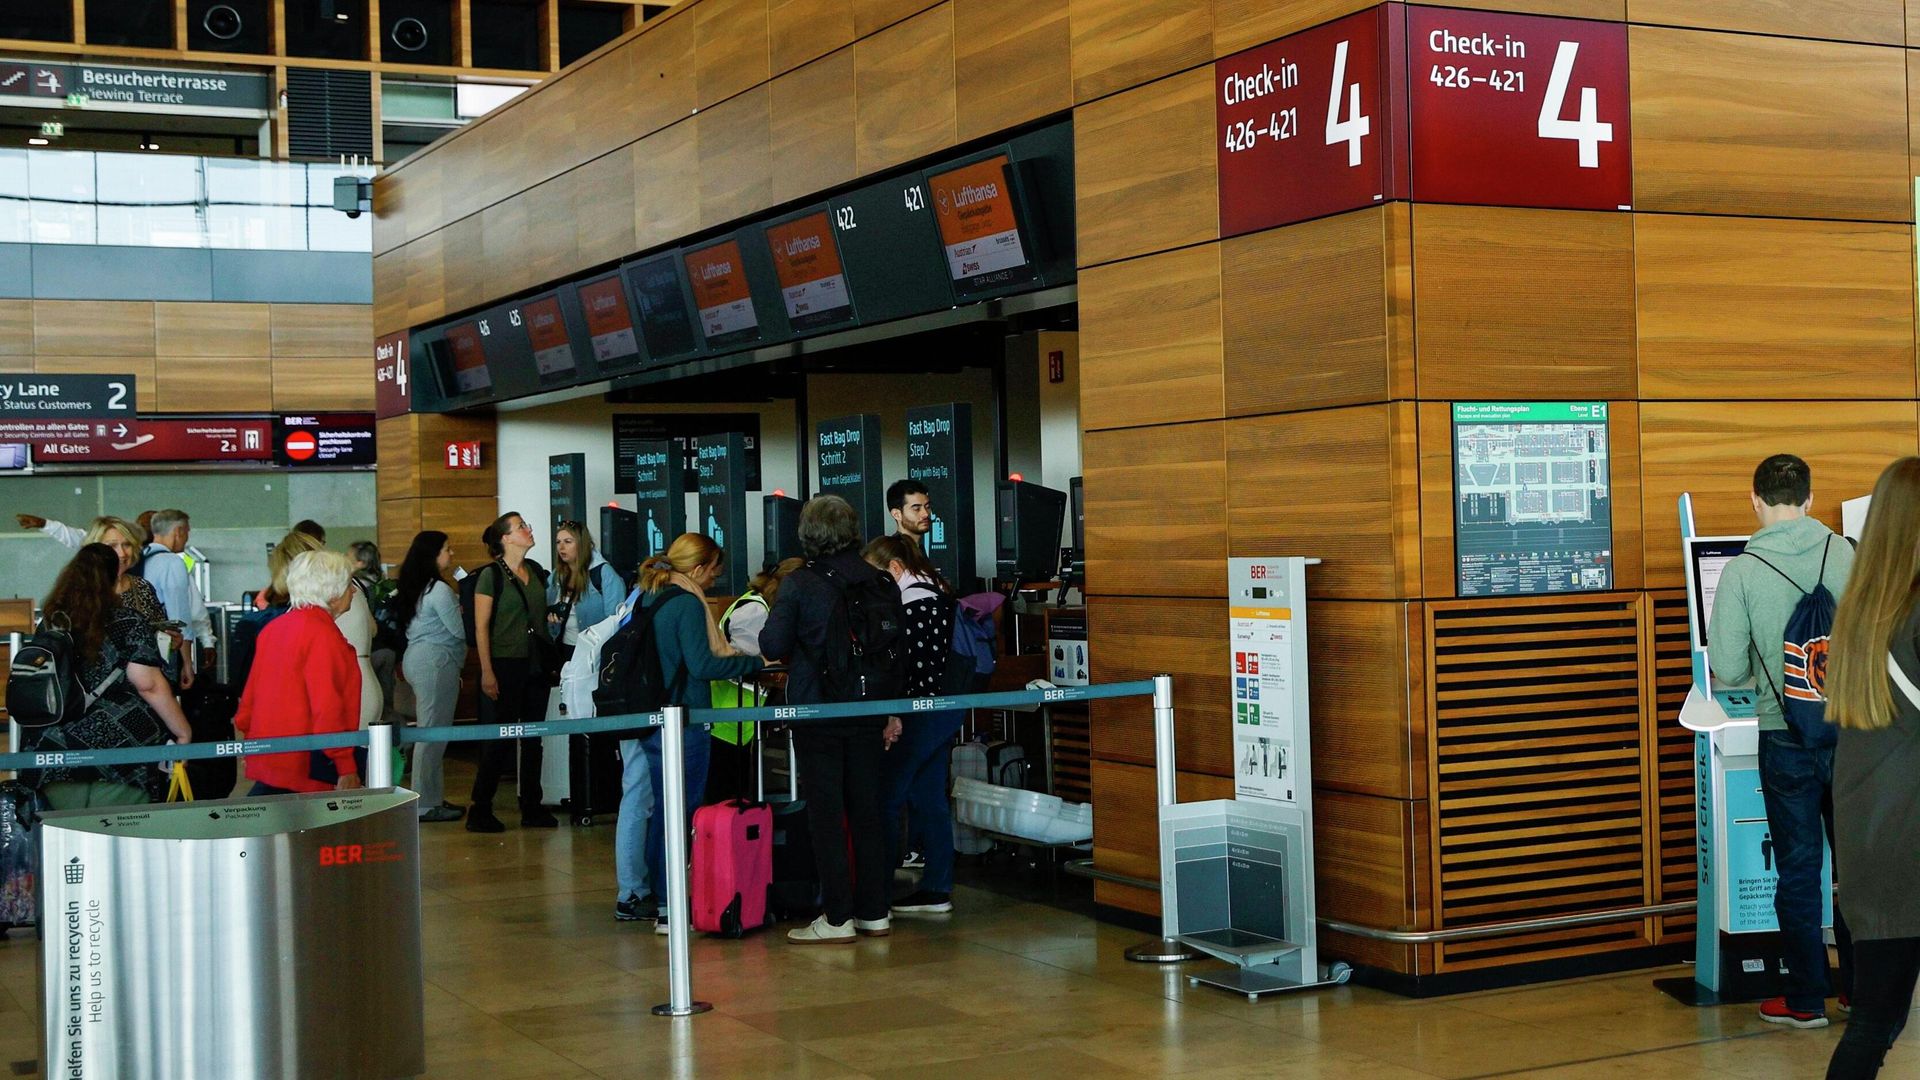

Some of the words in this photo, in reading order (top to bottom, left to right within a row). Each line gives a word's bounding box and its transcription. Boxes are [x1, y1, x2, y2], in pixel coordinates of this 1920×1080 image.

[1429, 29, 1526, 58] Check-in
[82, 70, 227, 91] Besucherterrasse
[1224, 57, 1298, 106] Check-in
[1430, 64, 1524, 92] 426–421
[138, 90, 184, 104] Terrace
[1326, 40, 1370, 167] 4
[1538, 40, 1613, 168] 4
[1225, 106, 1297, 153] 426–421
[904, 186, 924, 212] 421
[952, 183, 998, 208] Lufthansa
[836, 206, 856, 231] 422
[785, 235, 820, 256] Lufthansa
[396, 340, 407, 396] 4
[18, 382, 60, 396] Lane
[108, 382, 128, 410] 2
[4, 400, 36, 410] Status
[38, 400, 92, 410] Customers
[1491, 406, 1530, 414] Rettungsplan
[1592, 406, 1606, 418] E1
[909, 421, 923, 436] Fast
[923, 420, 935, 437] Bag
[936, 419, 950, 436] Drop
[820, 433, 833, 446] Fast
[834, 432, 846, 447] Bag
[846, 430, 860, 445] Drop
[43, 443, 58, 454] All
[60, 443, 90, 454] Gates
[699, 447, 708, 459] Fast
[709, 446, 717, 460] Bag
[717, 445, 727, 459] Drop
[910, 443, 924, 460] Step
[925, 442, 930, 456] 2
[637, 454, 647, 465] Fast
[647, 453, 656, 467] Bag
[656, 452, 666, 466] Drop
[821, 452, 842, 466] Schritt
[842, 451, 846, 464] 2
[700, 464, 710, 478] Step
[710, 464, 714, 476] 2
[911, 468, 922, 480] Only
[822, 476, 831, 486] Nur
[1250, 566, 1266, 579] BER
[1044, 690, 1064, 700] BER
[775, 708, 796, 719] BER
[913, 700, 934, 710] BER
[649, 714, 664, 724] BE
[500, 725, 524, 736] BER
[216, 743, 243, 755] BER
[36, 753, 64, 765] BER
[1698, 734, 1708, 827] Check-i
[224, 806, 266, 814] Verpackung
[320, 845, 362, 866] BER
[1700, 834, 1708, 886] Self
[65, 901, 84, 960] recyceln
[86, 899, 104, 948] recycle
[88, 950, 101, 967] to
[70, 964, 81, 982] zu
[90, 970, 101, 986] us
[70, 986, 81, 1011] uns
[87, 992, 105, 1022] Help
[67, 1016, 82, 1036] Sie
